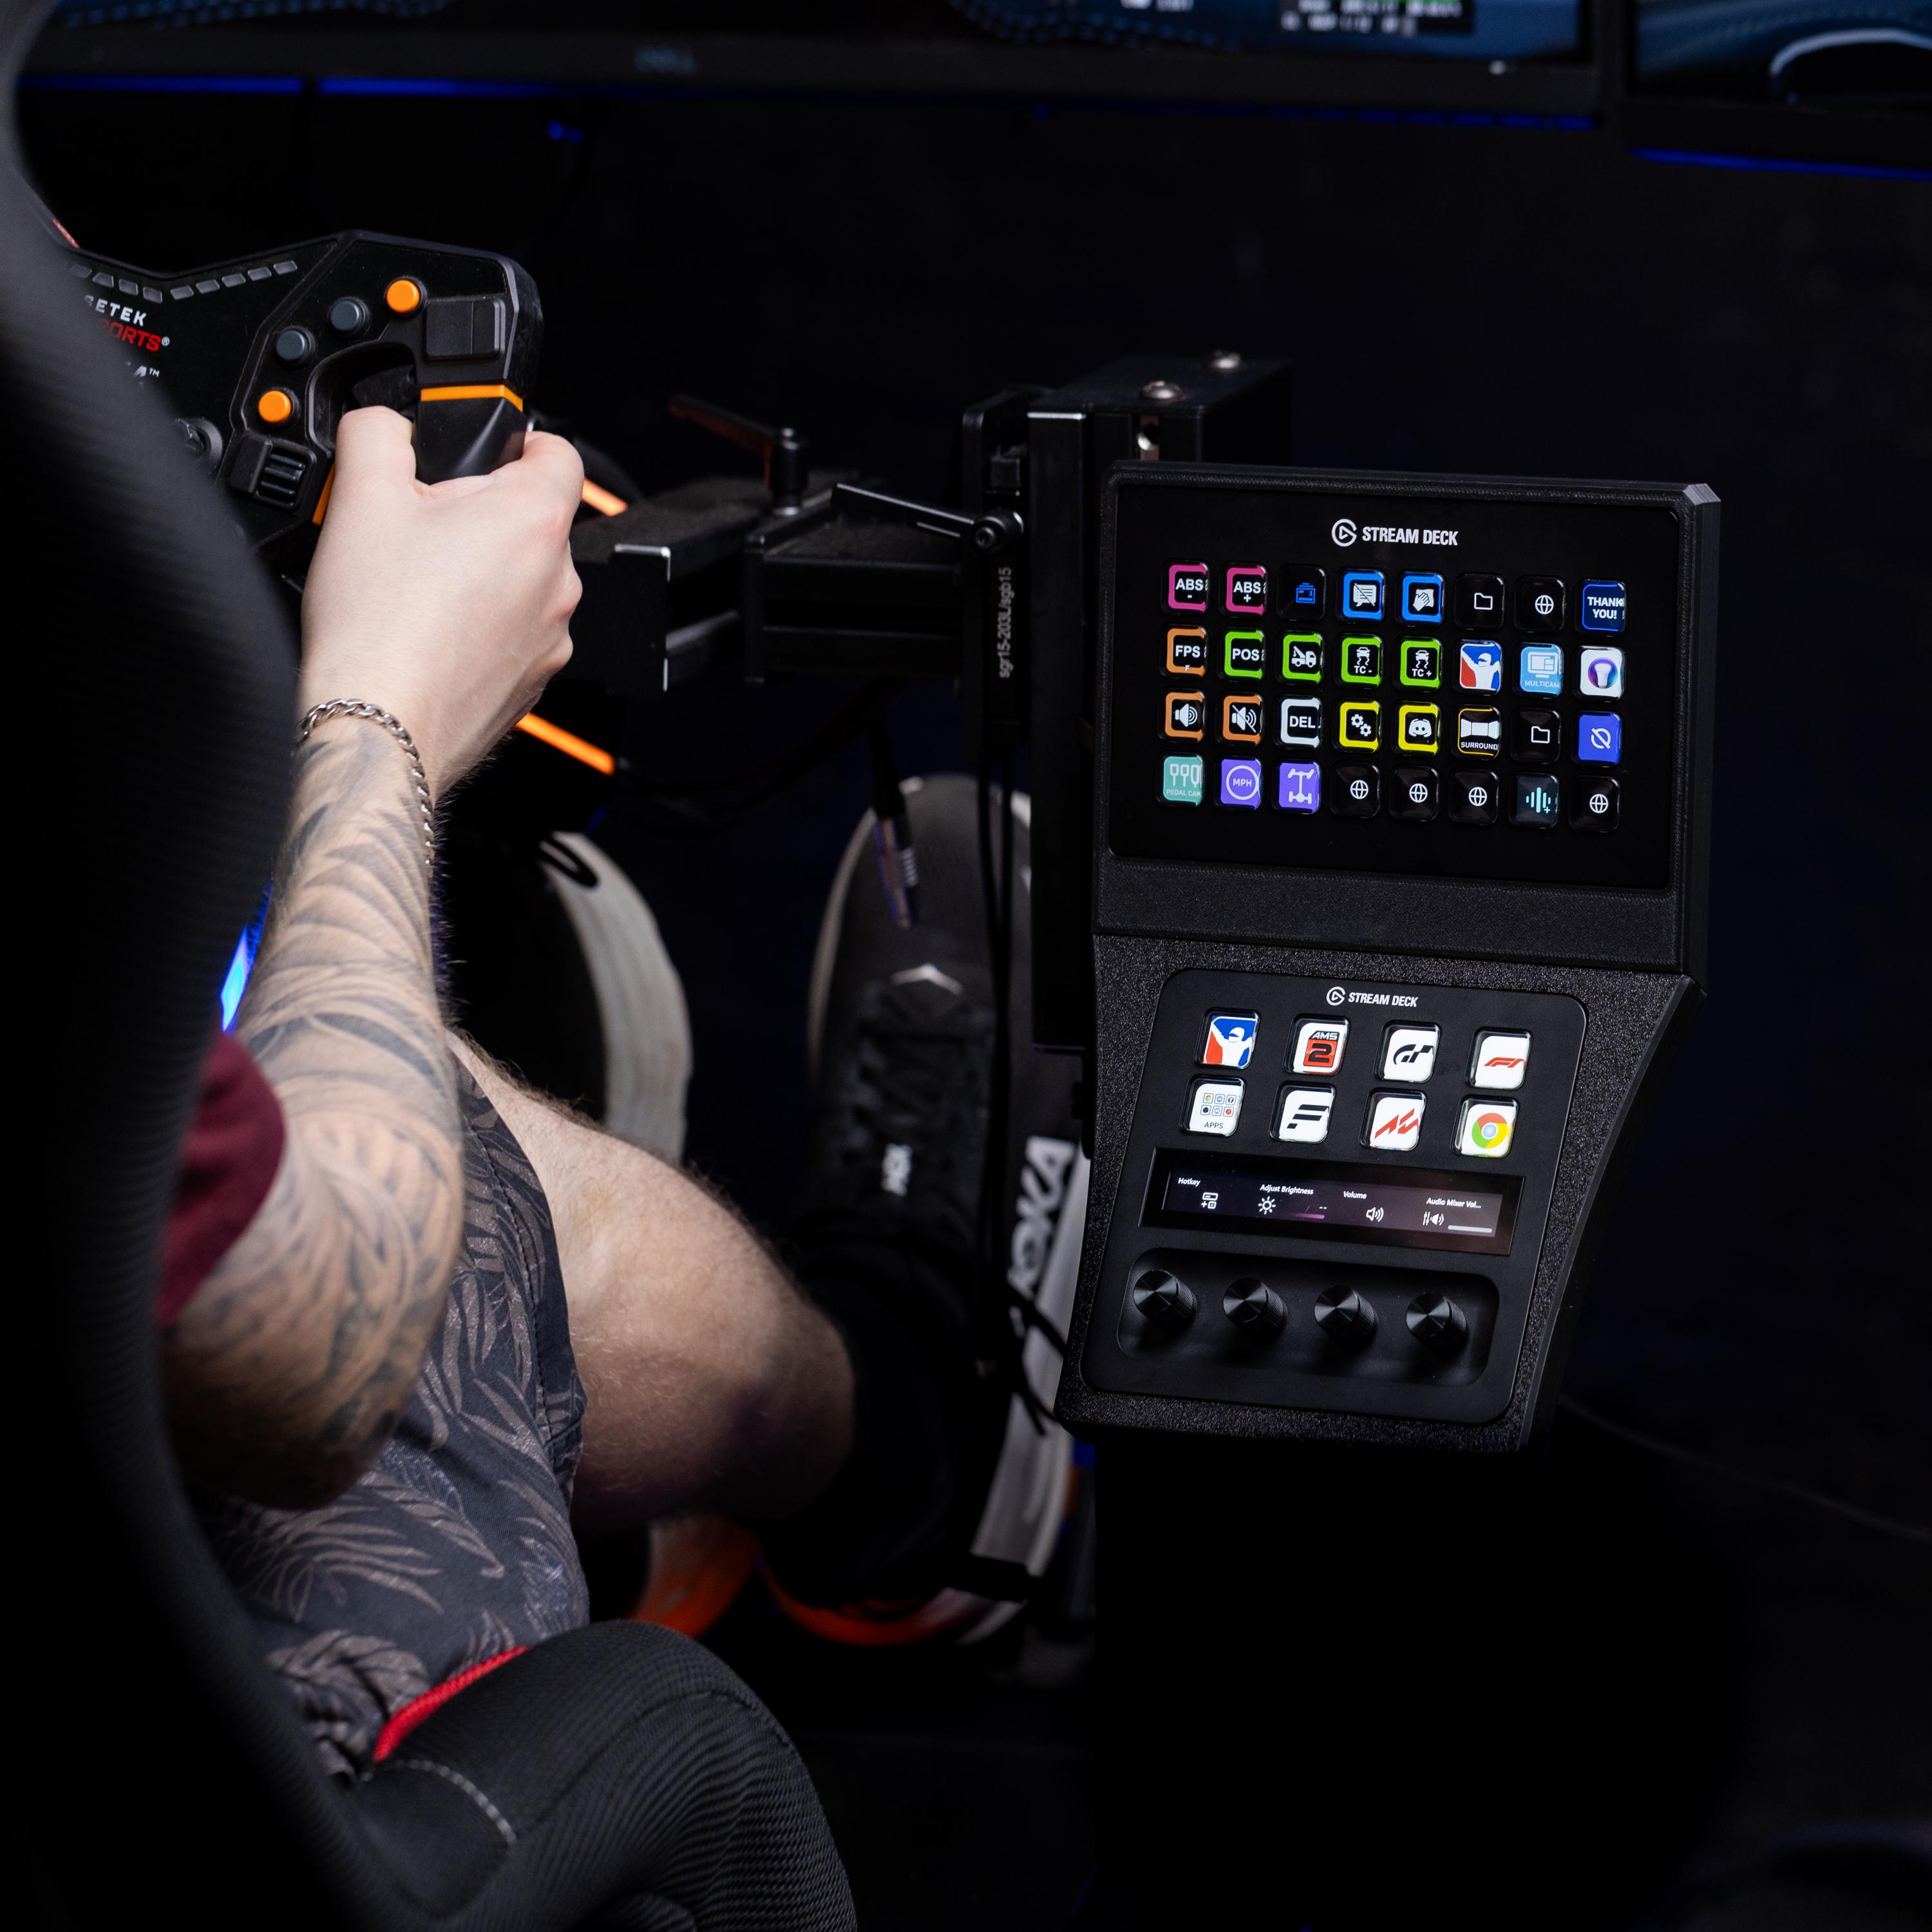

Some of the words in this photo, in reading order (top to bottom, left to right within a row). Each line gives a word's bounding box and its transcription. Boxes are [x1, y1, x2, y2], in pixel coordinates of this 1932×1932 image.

[1362, 526, 1419, 544] STREAM
[1423, 529, 1459, 545] DECK
[1175, 579, 1204, 591] ABS
[1233, 582, 1261, 593] ABS
[1587, 596, 1625, 607] THANK
[1592, 609, 1617, 619] YOU!
[1175, 645, 1200, 658] FPS
[1233, 649, 1260, 661] POS
[1354, 665, 1366, 674] TC
[1412, 668, 1424, 677] TC
[1289, 716, 1316, 728] DEL
[1232, 778, 1252, 787] MPH
[1348, 992, 1390, 1005] STREAM
[1392, 995, 1418, 1007] DECK
[1311, 1032, 1338, 1041] AMS
[1308, 1043, 1332, 1063] 2
[1178, 1178, 1200, 1187] Hotkey
[1260, 1184, 1280, 1193] Adjust
[1281, 1186, 1314, 1195] Brightness
[1343, 1191, 1367, 1199] Volume
